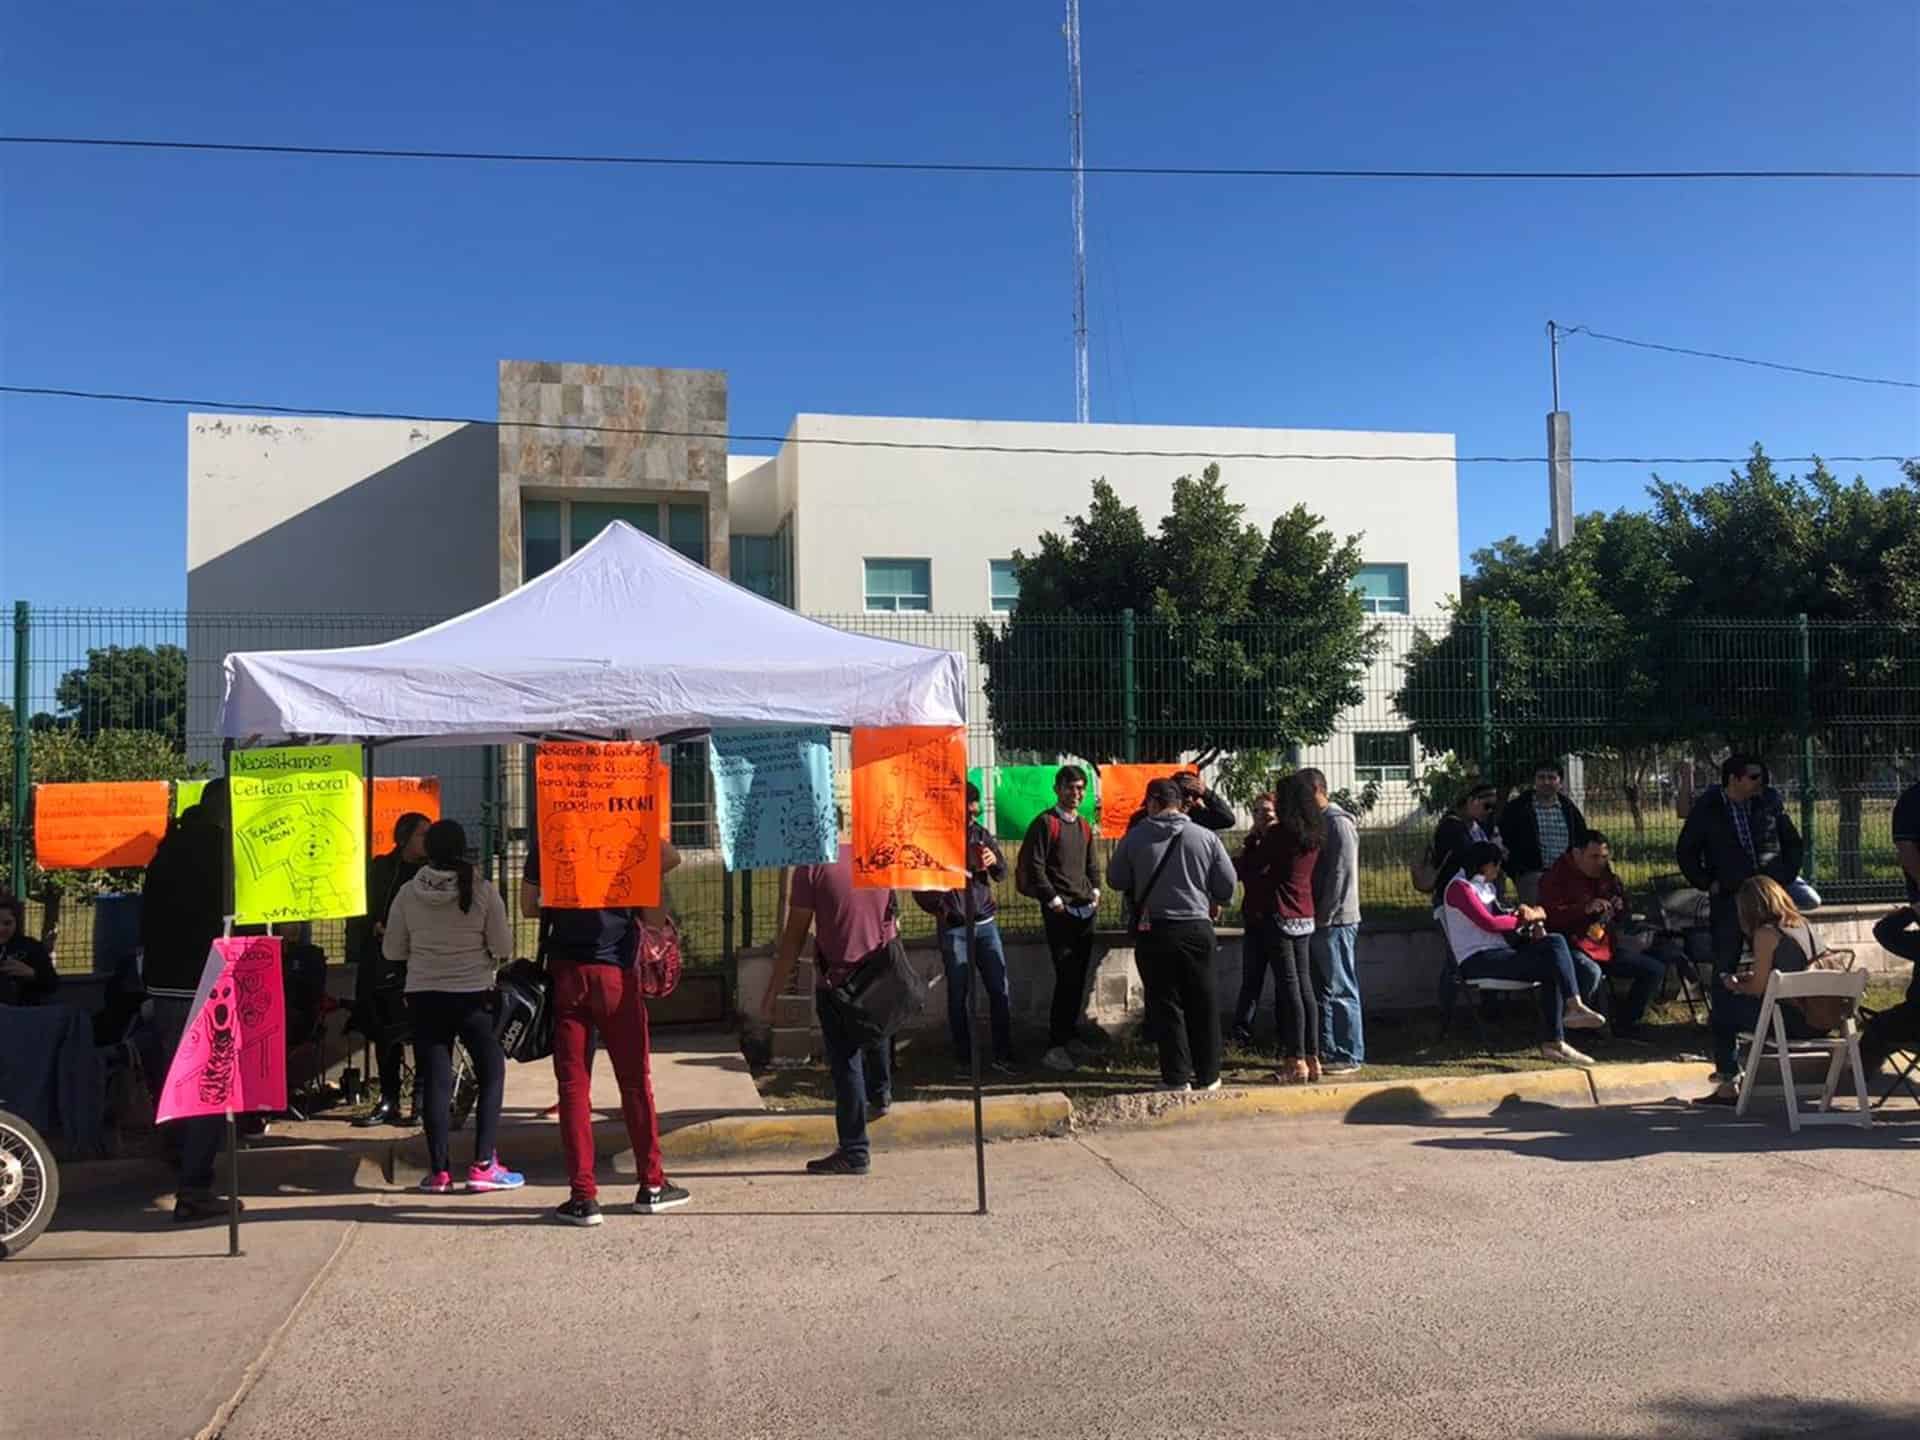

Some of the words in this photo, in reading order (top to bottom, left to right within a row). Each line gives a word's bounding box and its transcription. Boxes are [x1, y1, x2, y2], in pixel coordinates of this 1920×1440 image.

[235, 752, 333, 770] Necesitamos
[297, 774, 350, 791] laboral
[609, 794, 654, 813] PRONI
